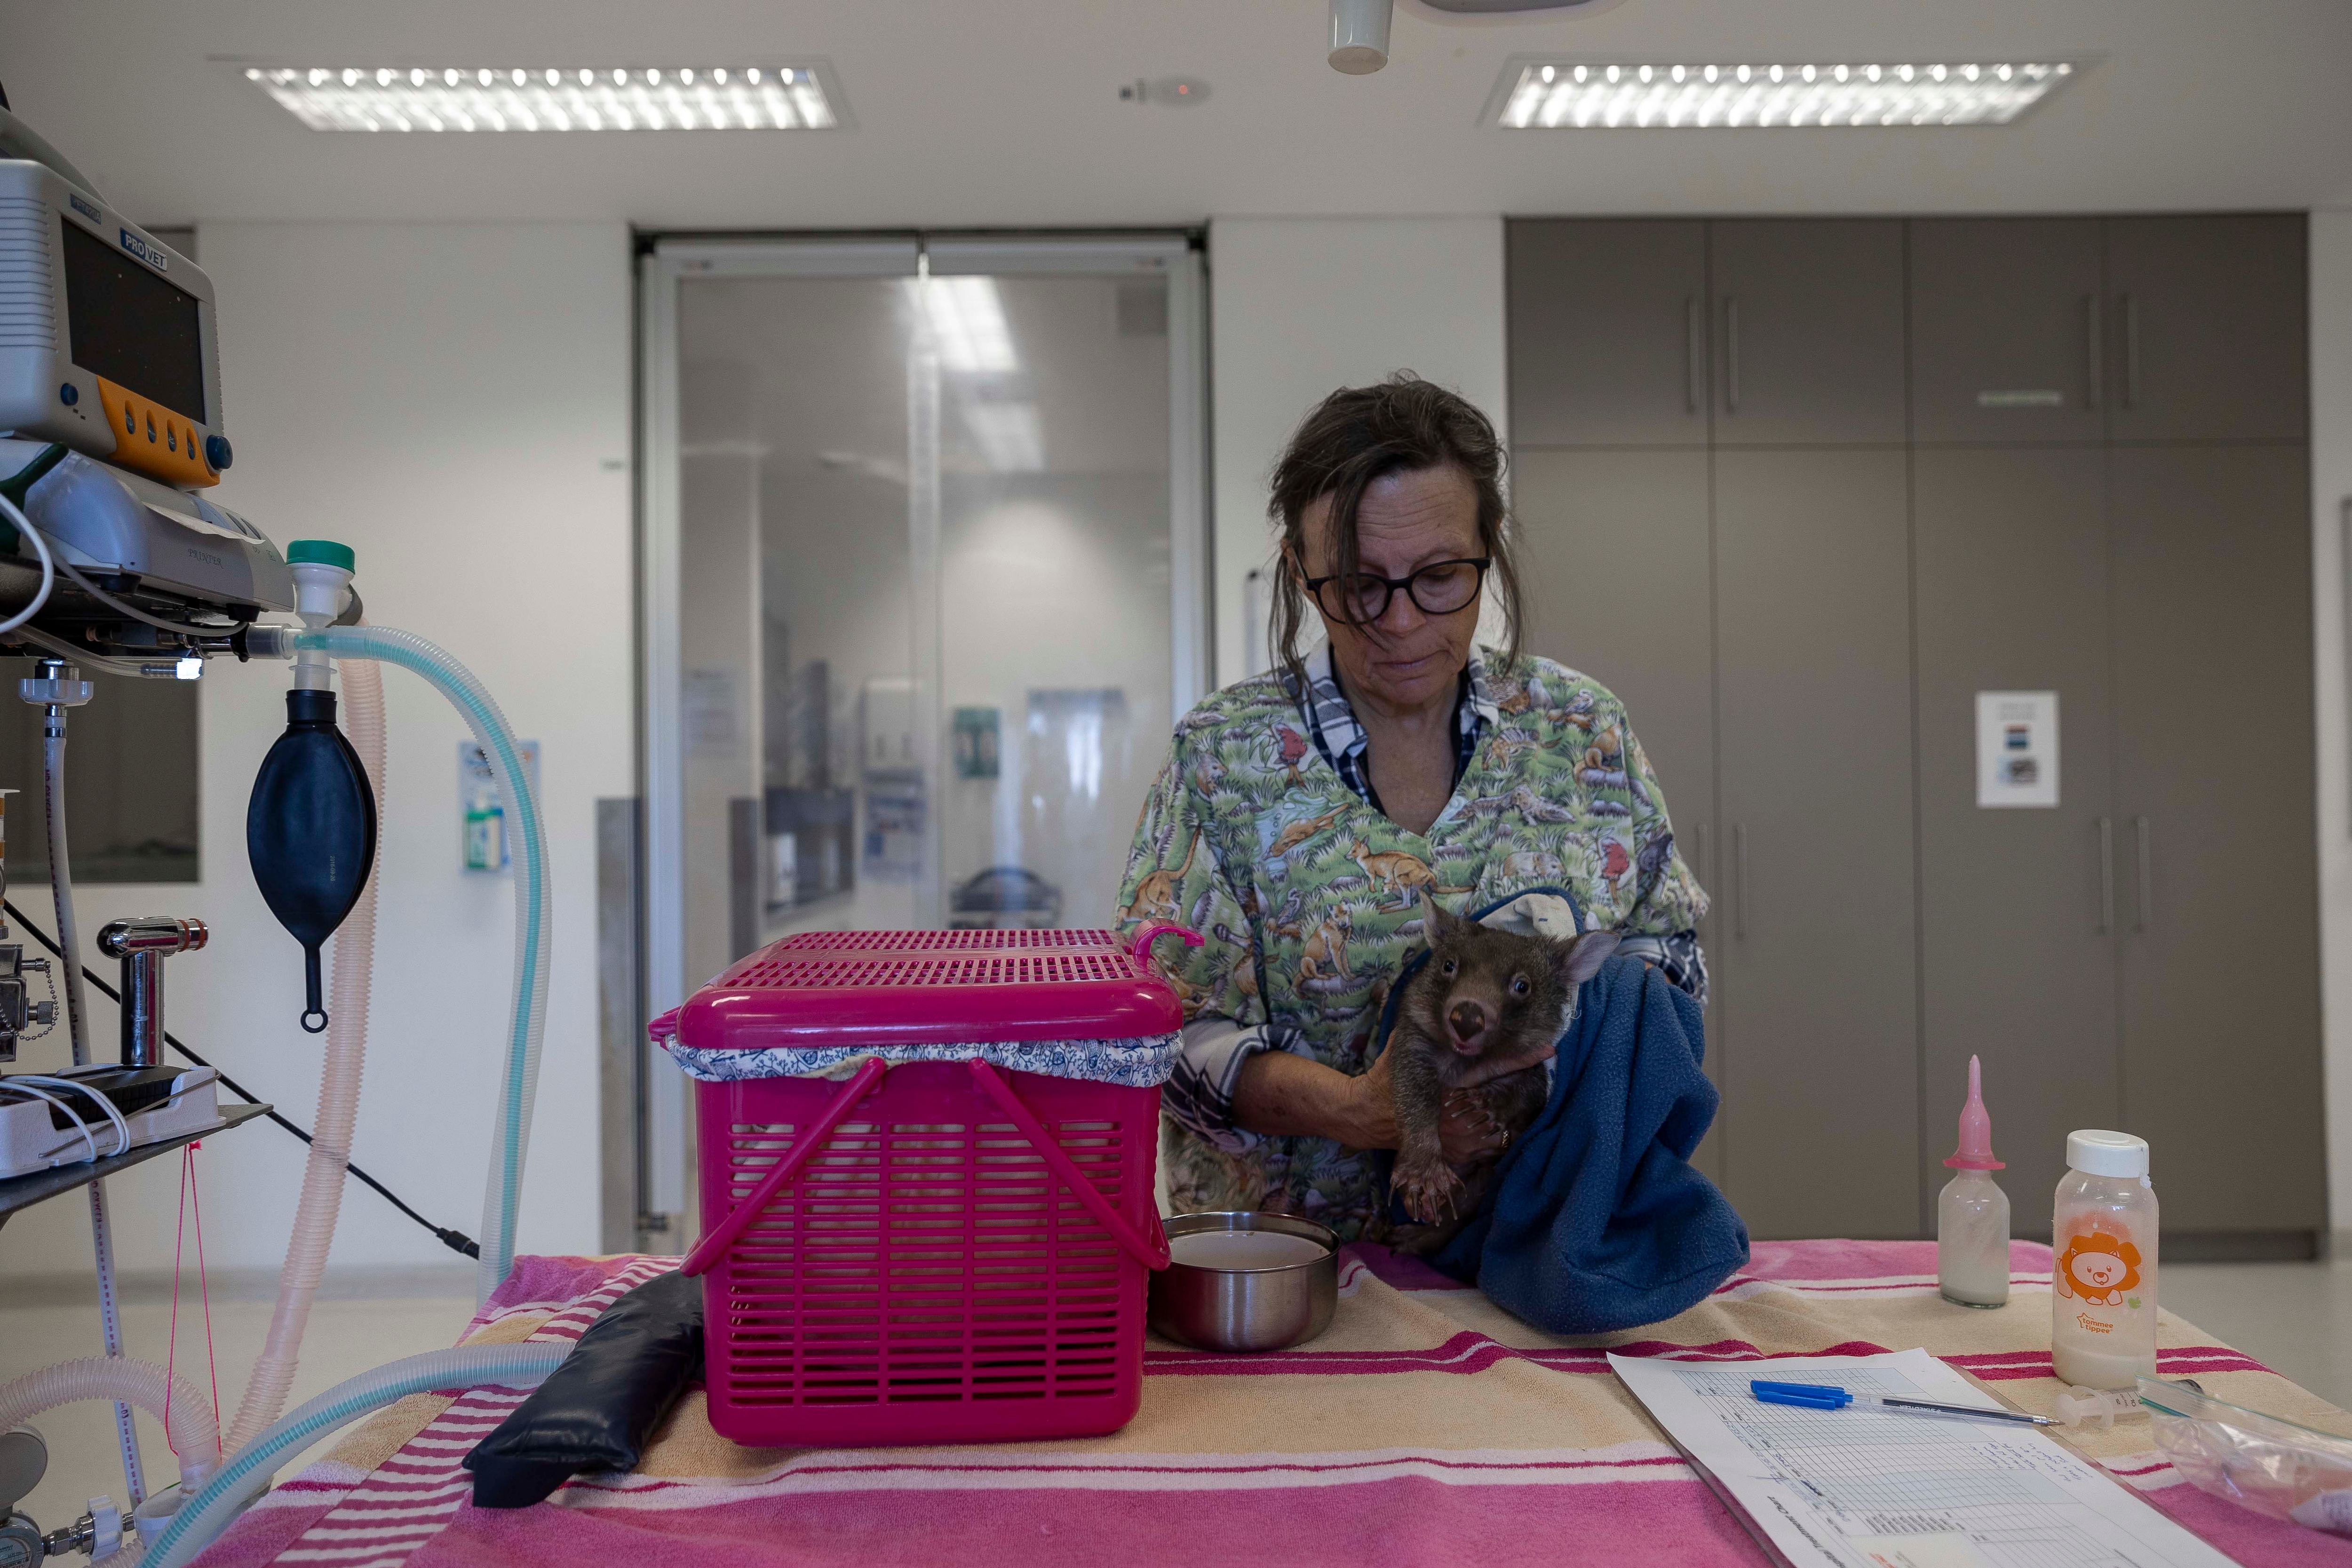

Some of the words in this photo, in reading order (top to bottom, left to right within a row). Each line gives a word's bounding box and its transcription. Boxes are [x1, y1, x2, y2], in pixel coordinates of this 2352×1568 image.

[188, 548, 224, 569] PRINTER
[2082, 1318, 2114, 1328] tommee
[2085, 1324, 2110, 1334] tippee
[1767, 1496, 1788, 1514] Chart
[1785, 1515, 1824, 1548] Treatment
